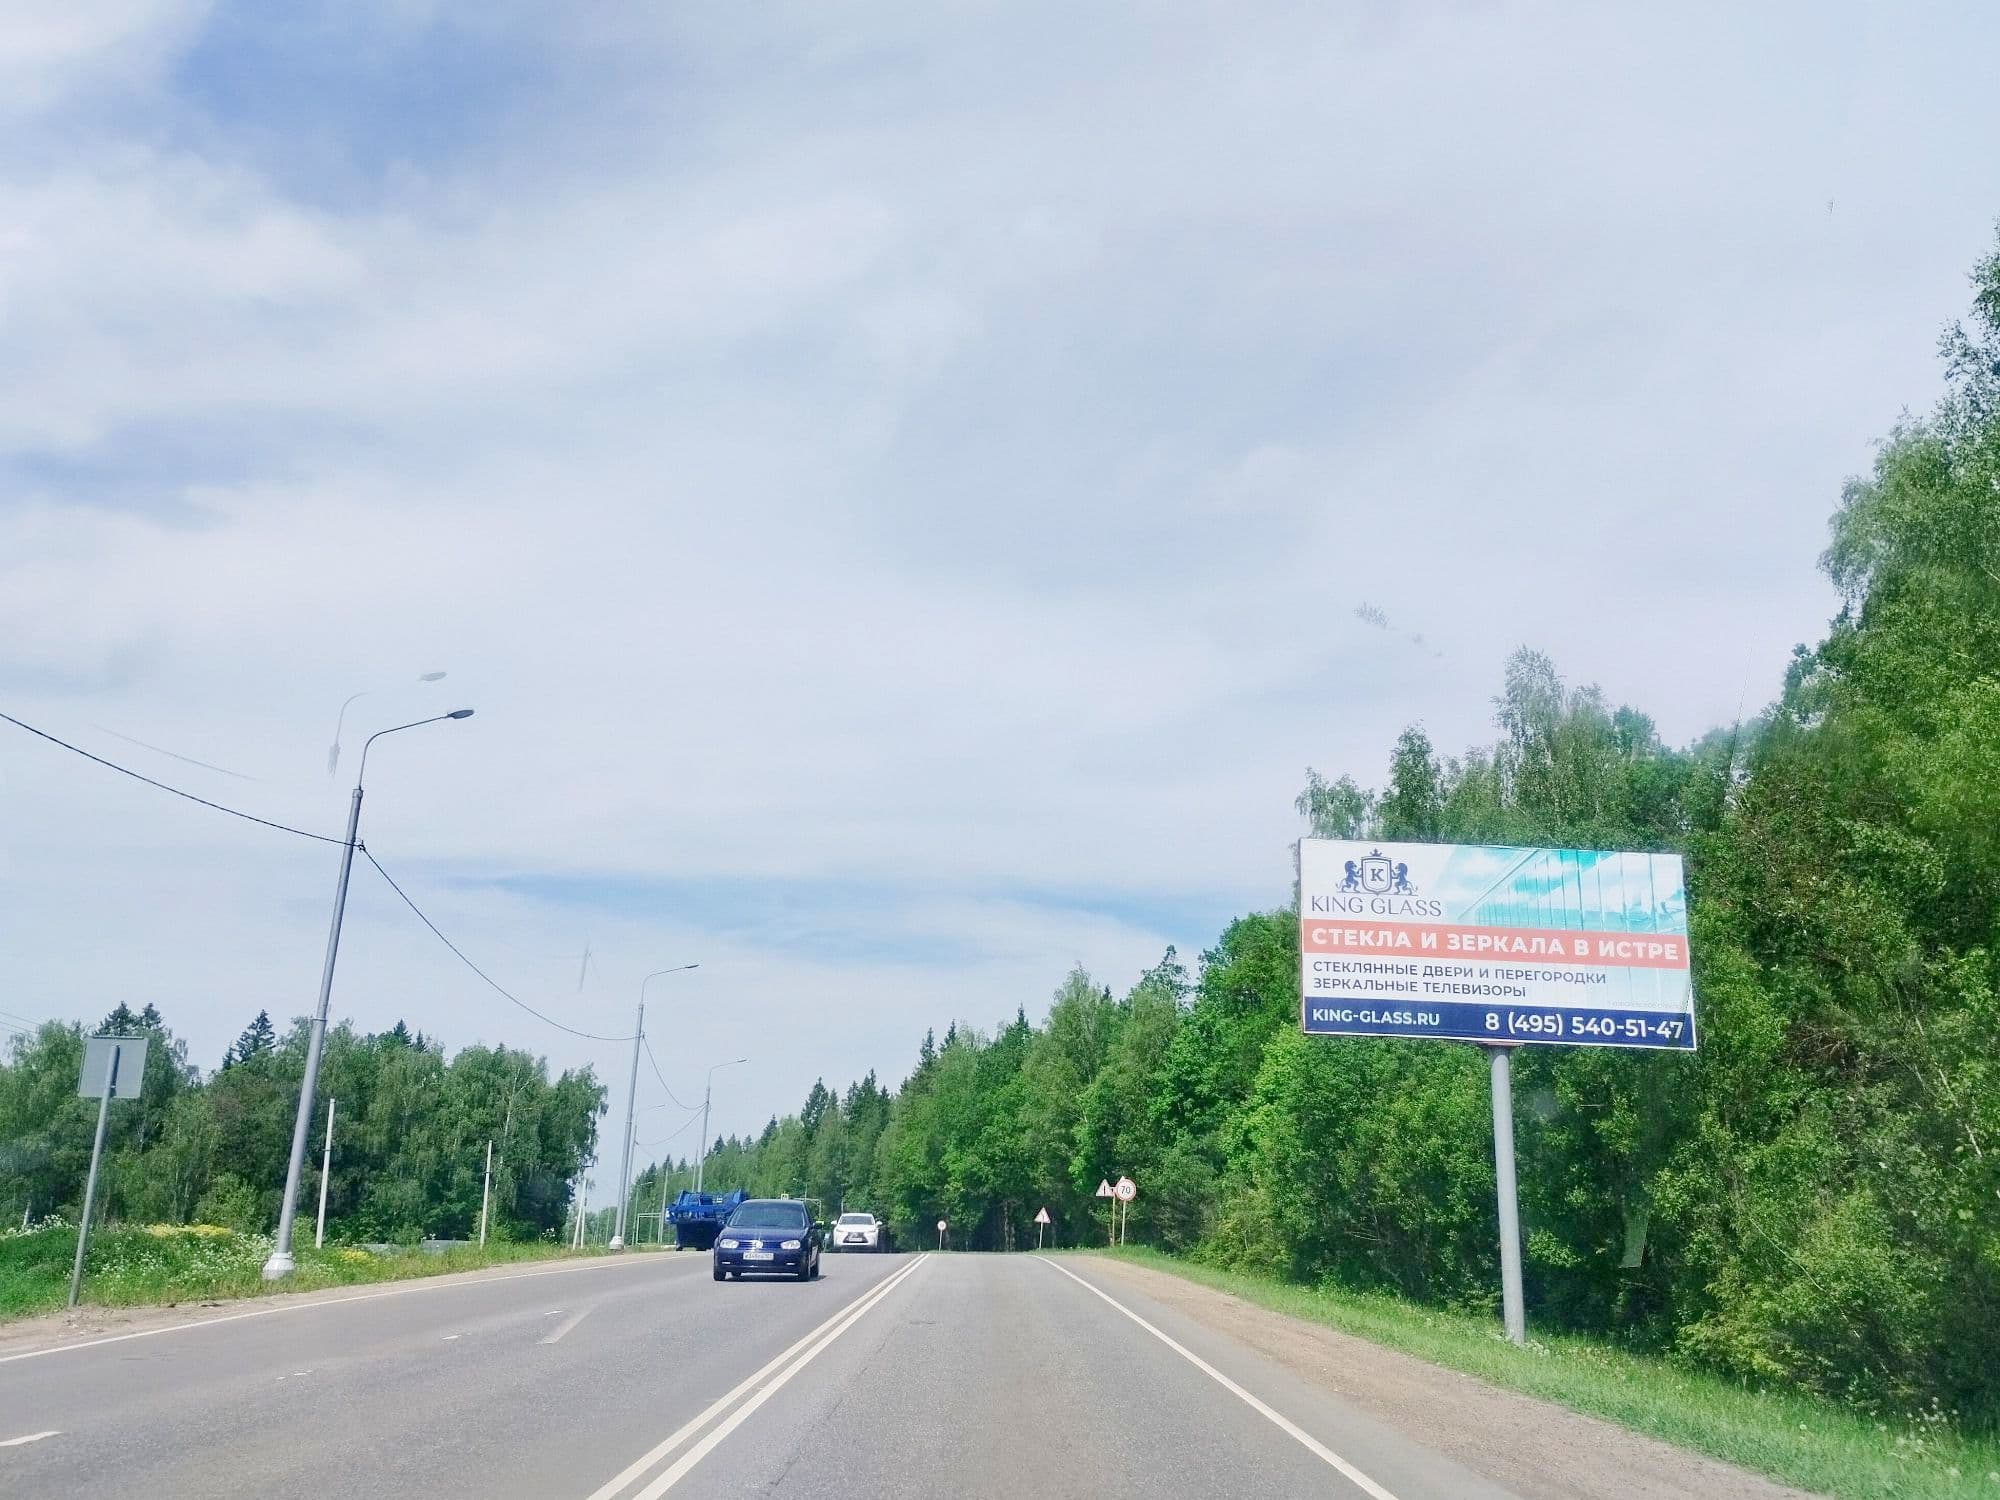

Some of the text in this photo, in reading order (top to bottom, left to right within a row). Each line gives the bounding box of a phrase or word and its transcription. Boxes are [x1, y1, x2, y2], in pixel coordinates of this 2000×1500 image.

[1370, 868, 1384, 882] K
[1311, 895, 1442, 917] KING GLASS
[1311, 927, 1679, 960] СТЕКЛА И ЗЕРКАЛА В ИСТРЕ
[1313, 960, 1606, 985] СТЕКЛЯННЫЕ ДВЕРИ И ПЕРЕГОРОДКИ
[1313, 977, 1526, 997] ЗЕРКАЛЬНЫЕ ТЕЛЕВИЗОРЫ
[1312, 1008, 1440, 1027] KING-GLASS.RU
[1485, 1012, 1683, 1039] 8 (495) 540-51-47
